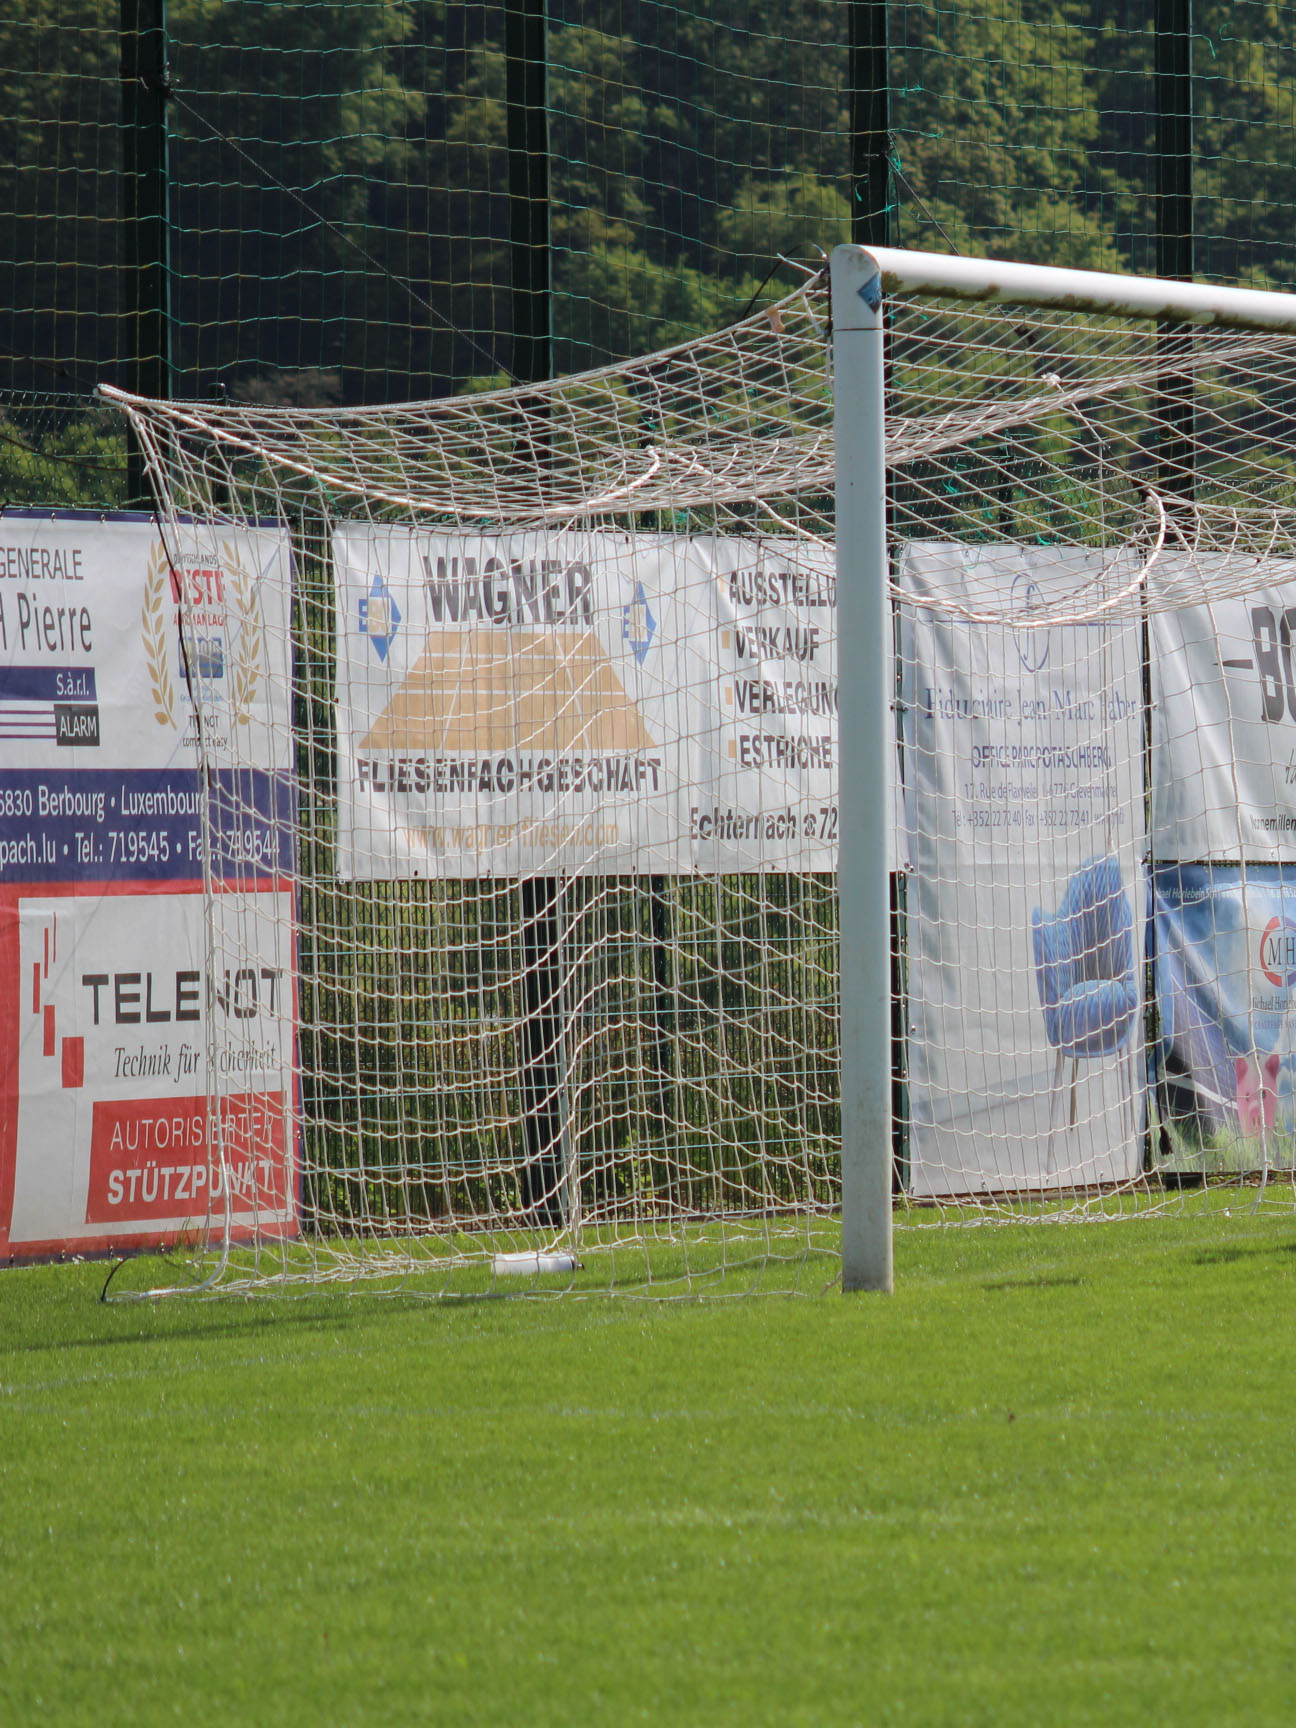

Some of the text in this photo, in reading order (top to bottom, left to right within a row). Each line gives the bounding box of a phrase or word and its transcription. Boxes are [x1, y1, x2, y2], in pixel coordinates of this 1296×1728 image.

[0, 546, 84, 580] GENERALE
[423, 555, 594, 627] WAGNER
[17, 592, 92, 652] Pierre
[735, 626, 820, 661] VERKAUF
[735, 679, 839, 716] VERLEGUN
[59, 715, 97, 737] ALARM
[739, 734, 834, 770] ESTRICHE
[357, 756, 662, 794] FLIESENFACHGESCHÄFT
[38, 785, 105, 822] Berbourg
[121, 784, 208, 820] Luxembour
[690, 806, 797, 841] Echternach
[75, 831, 103, 863] Tel.:
[108, 831, 170, 863] 719545
[188, 830, 221, 861] Fa.:
[82, 968, 284, 1026] TELENOT
[114, 1039, 276, 1083] Technik für Scherheit
[110, 1111, 274, 1151] AUTORISIERTER
[107, 1159, 274, 1205] STÜTZPUNKT
